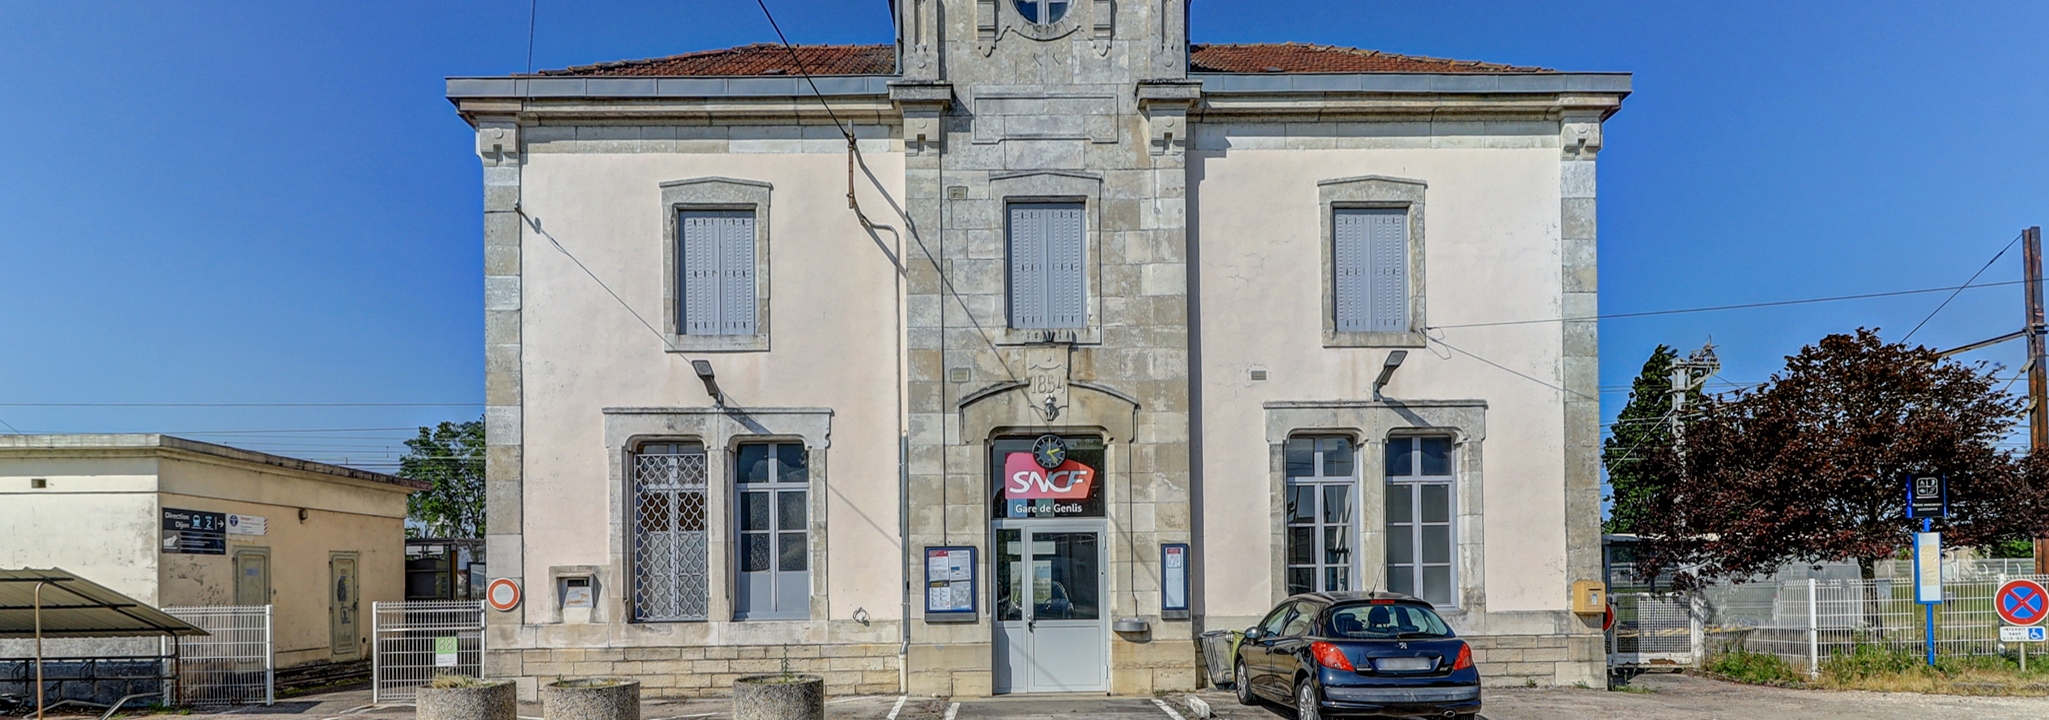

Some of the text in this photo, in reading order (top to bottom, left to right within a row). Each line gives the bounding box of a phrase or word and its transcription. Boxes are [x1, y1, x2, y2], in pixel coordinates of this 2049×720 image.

[1030, 374, 1065, 394] 1854
[1009, 470, 1088, 493] SNCF
[1015, 503, 1083, 513] Gare de Genlis
[164, 511, 190, 520] Direction
[175, 521, 190, 529] Dijon
[206, 520, 212, 528] 2
